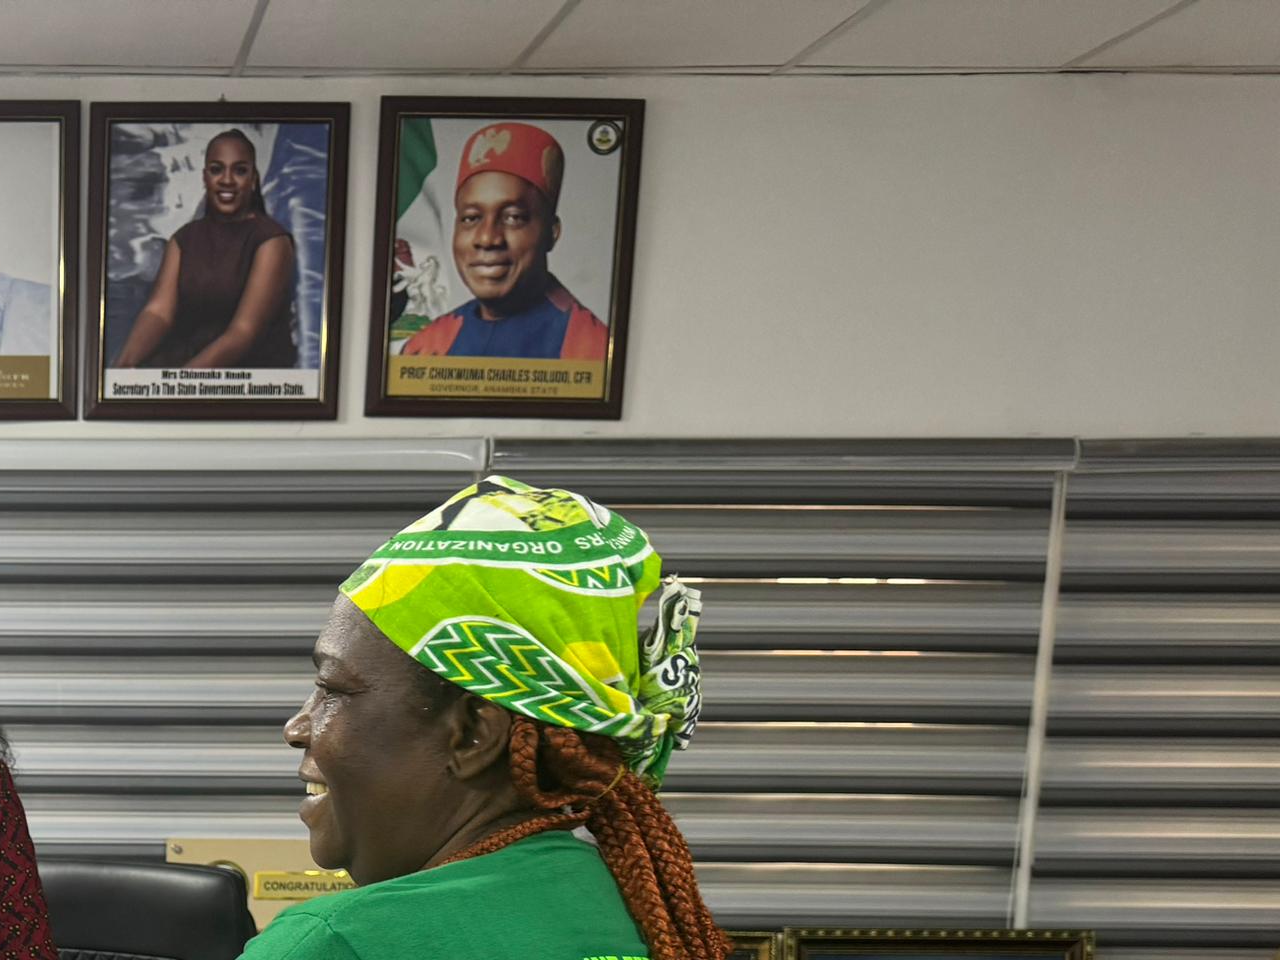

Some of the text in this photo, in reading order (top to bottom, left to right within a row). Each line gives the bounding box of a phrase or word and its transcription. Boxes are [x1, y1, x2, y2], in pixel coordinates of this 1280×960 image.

[429, 368, 485, 382] CHUKWUMA
[487, 369, 530, 383] CHARLES
[574, 371, 593, 384] CFR
[113, 383, 150, 397] Secretary
[151, 383, 160, 395] To
[162, 383, 176, 395] The
[177, 384, 197, 396] State
[248, 383, 282, 396] Anambra
[390, 538, 563, 555] ORGANIZATION
